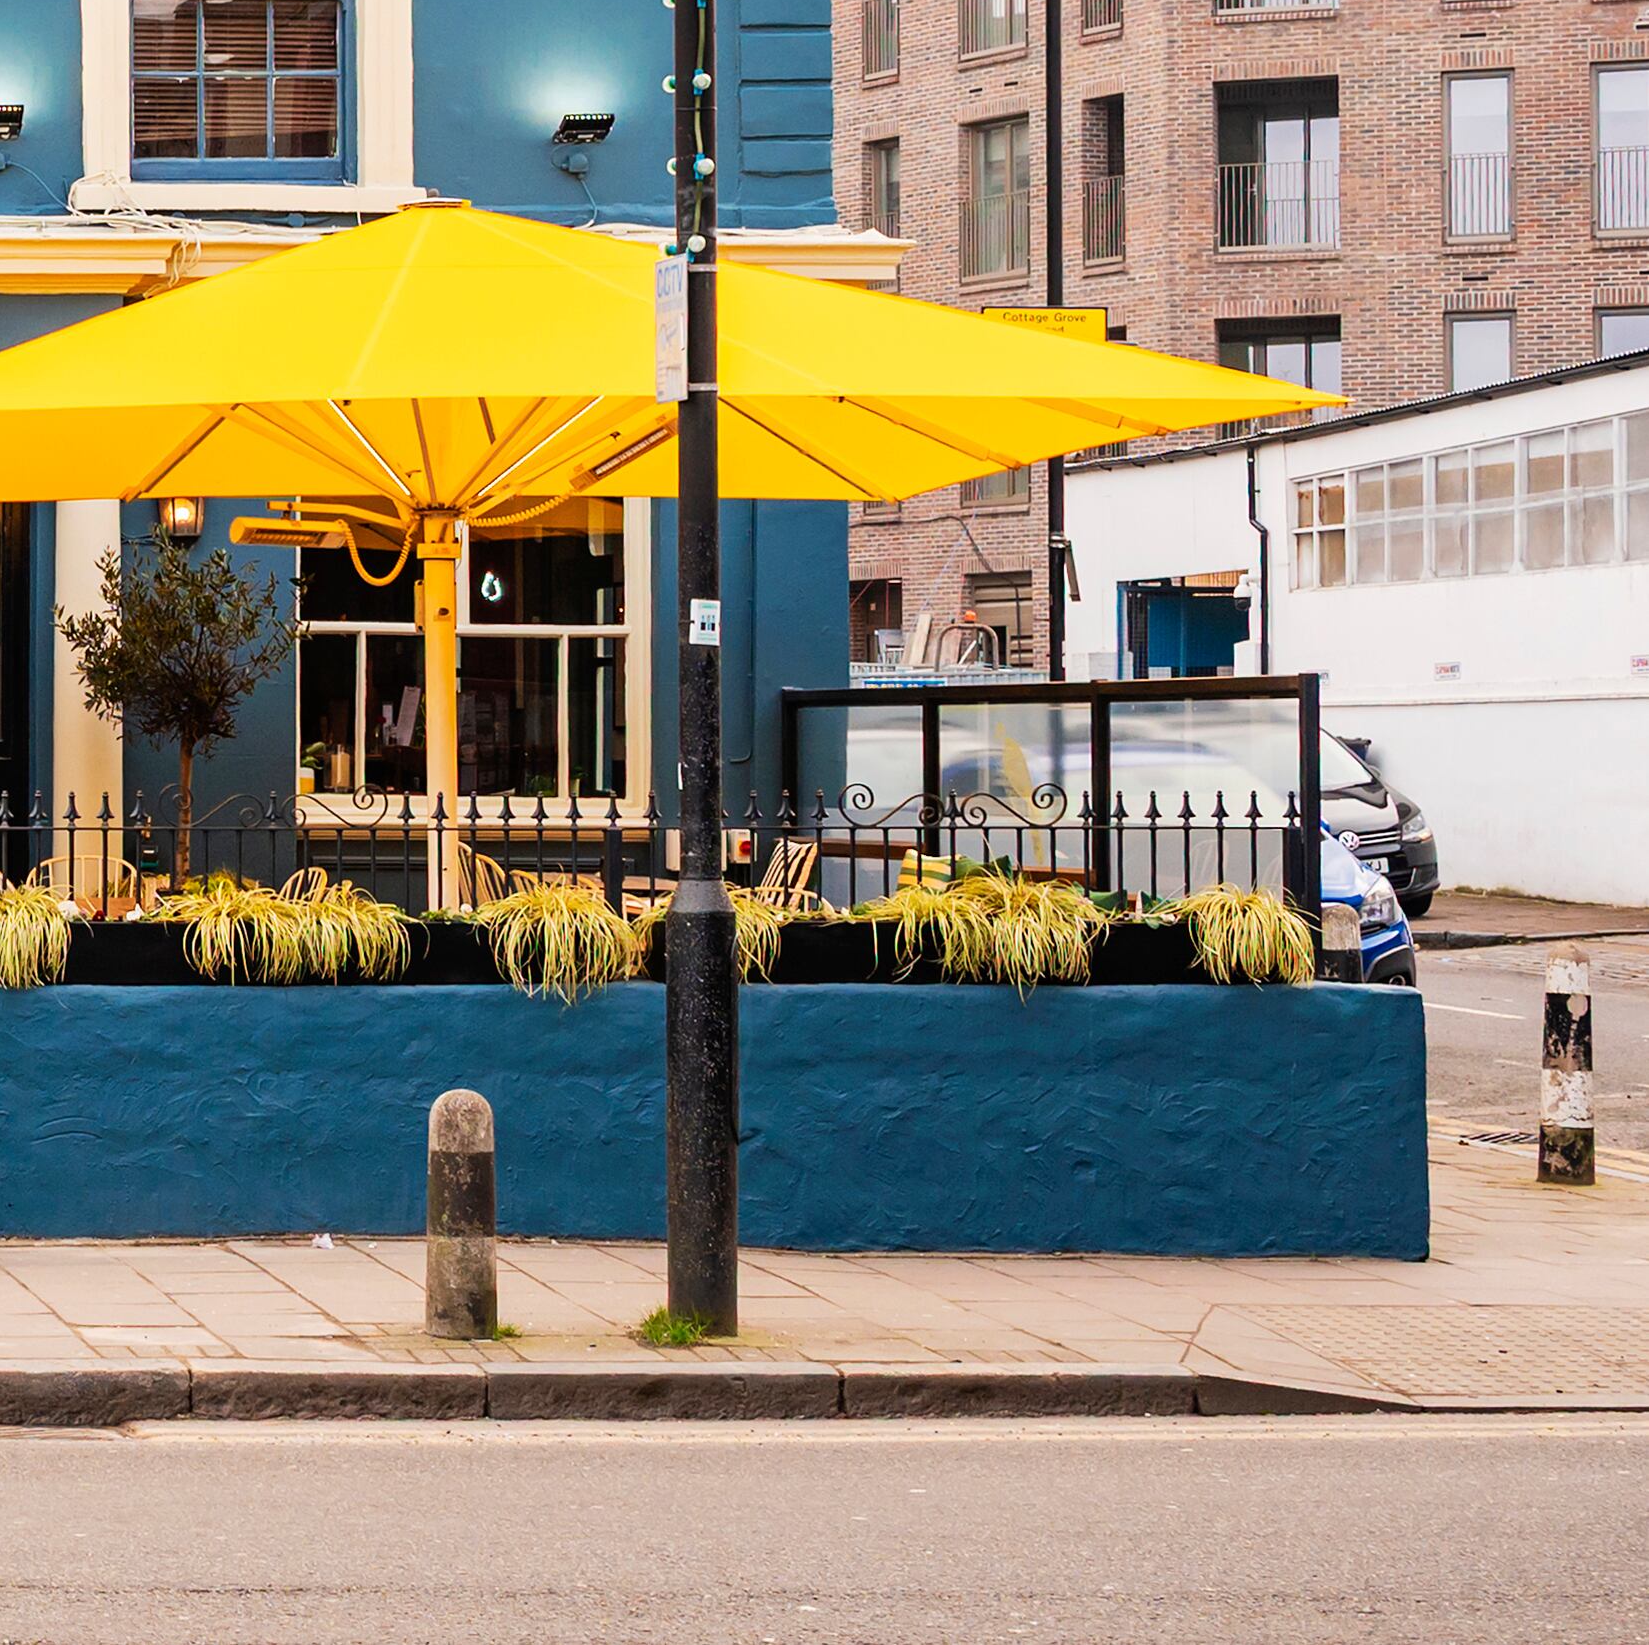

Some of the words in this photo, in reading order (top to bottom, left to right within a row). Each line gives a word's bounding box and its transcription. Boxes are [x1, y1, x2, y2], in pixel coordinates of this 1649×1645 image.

[657, 265, 683, 298] CCTV
[1002, 312, 1048, 323] Cottage
[1054, 312, 1086, 323] Grove
